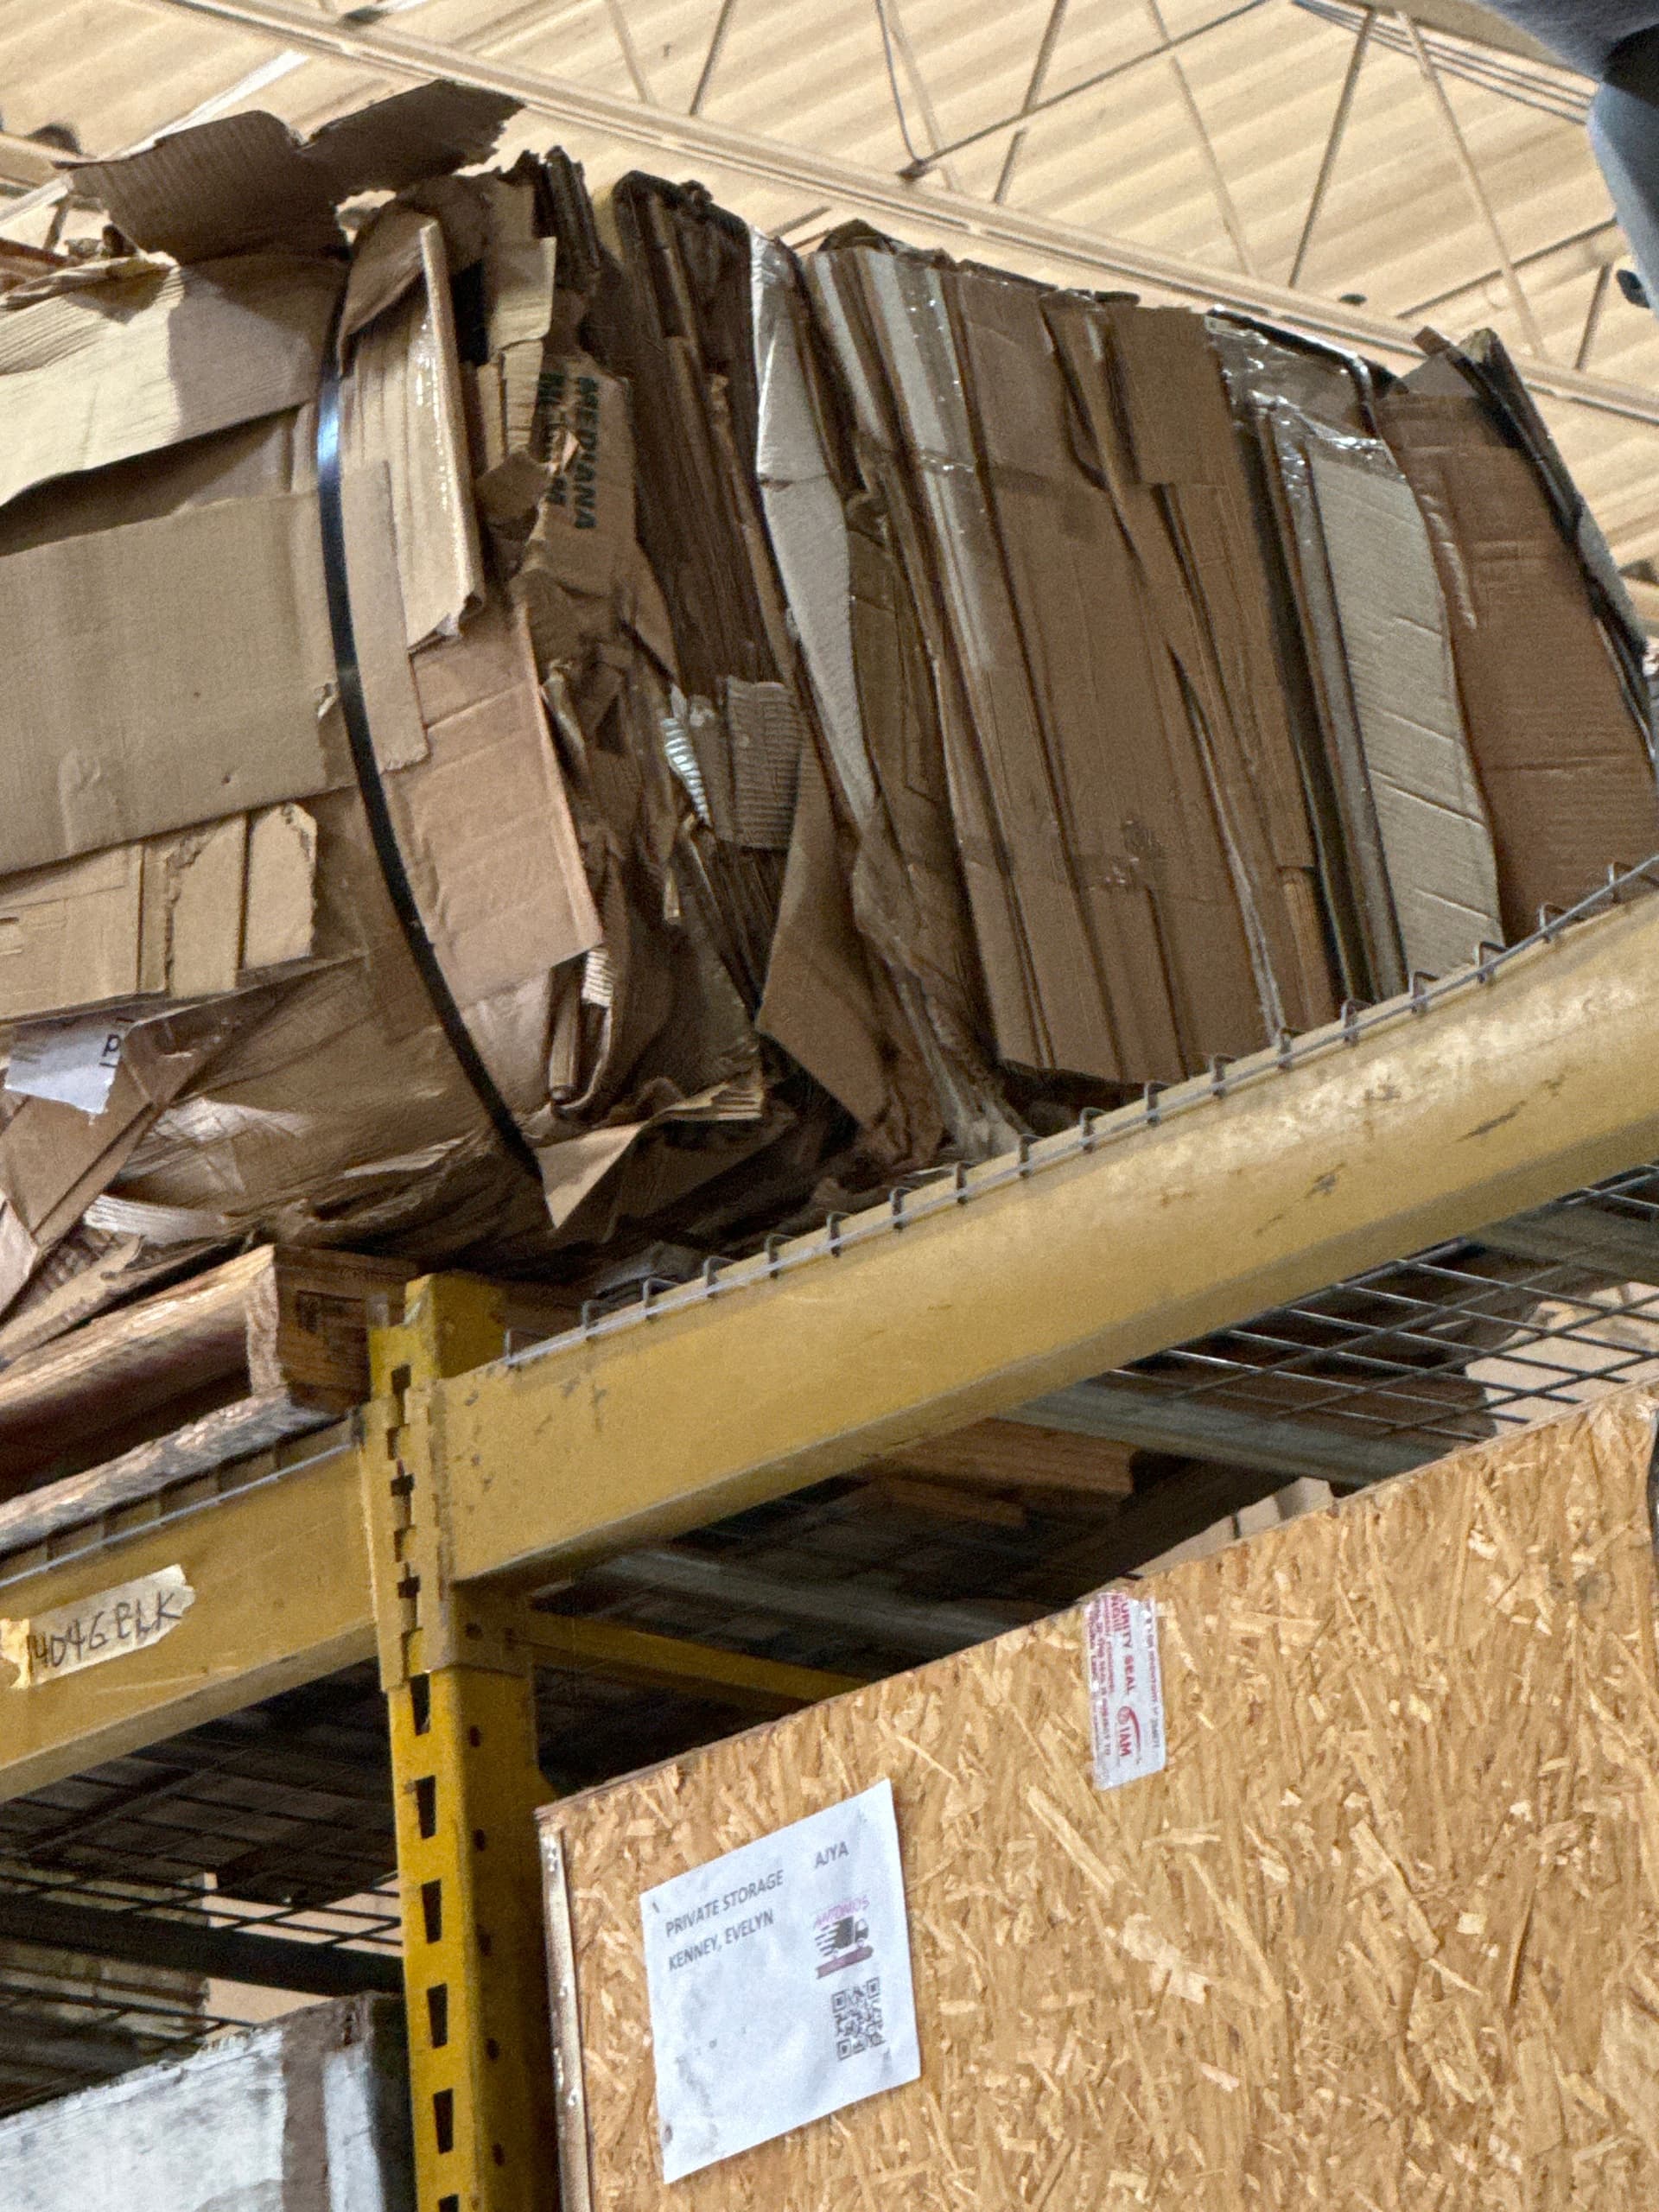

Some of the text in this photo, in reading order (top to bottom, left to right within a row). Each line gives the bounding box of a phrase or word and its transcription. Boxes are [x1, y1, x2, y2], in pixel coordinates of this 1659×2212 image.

[1119, 1726, 1132, 1757] IAM
[665, 1869, 785, 1937] PRIVATE STORAGE
[669, 1908, 774, 1972] KENNEY, EVELYN
